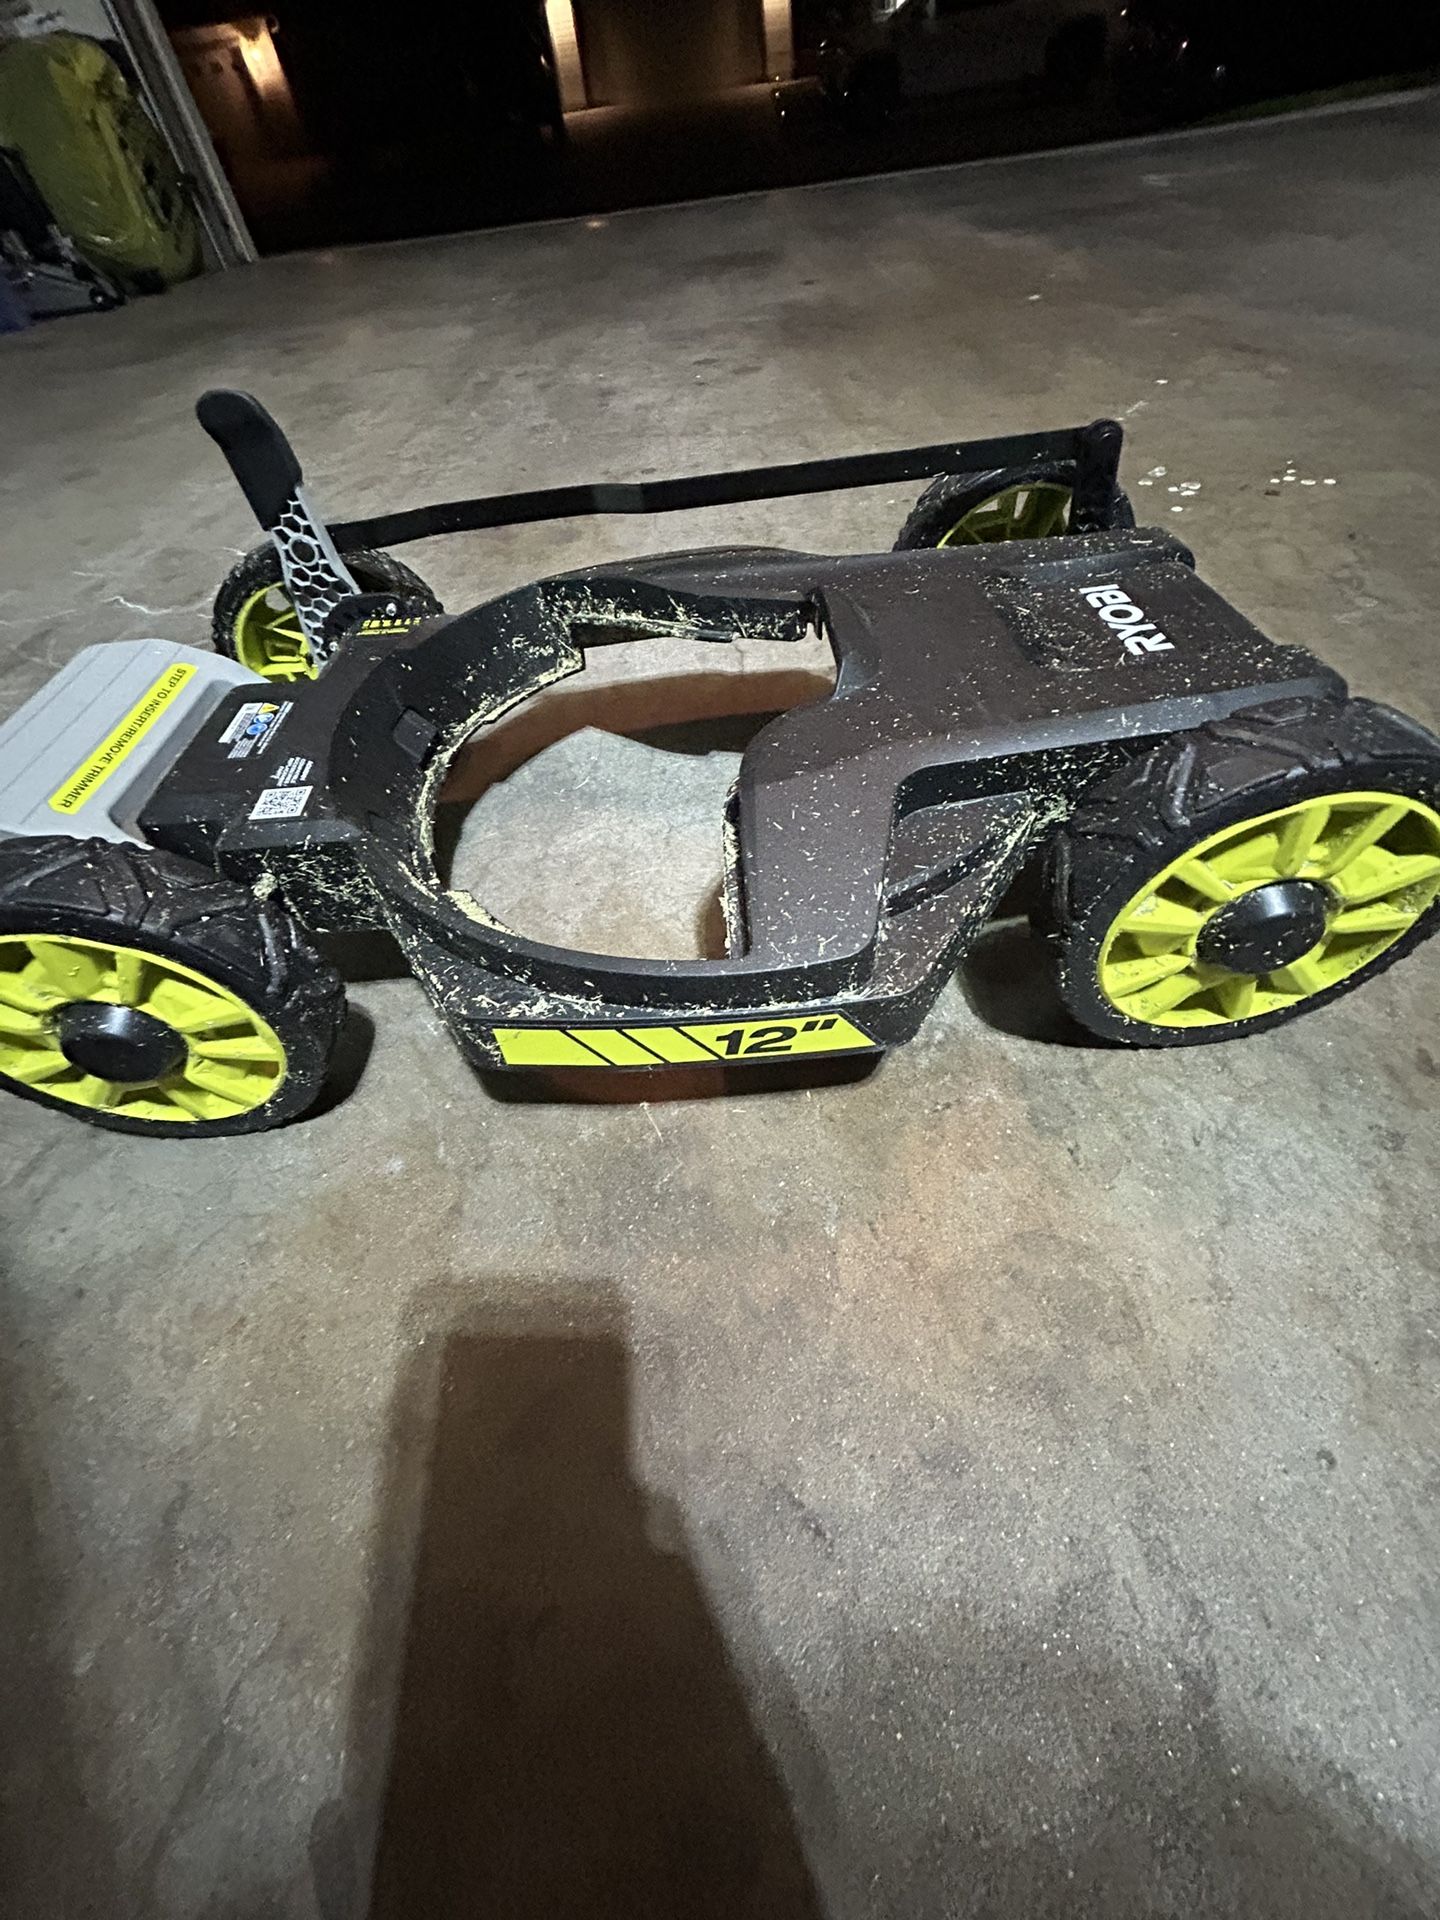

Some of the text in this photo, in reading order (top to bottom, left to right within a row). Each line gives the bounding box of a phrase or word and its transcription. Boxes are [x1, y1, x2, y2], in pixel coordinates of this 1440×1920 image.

[1078, 584, 1175, 656] RYOBI
[57, 668, 187, 808] STEP TO INSERT/REMOVE TRIMMER
[715, 1018, 839, 1056] 12"
